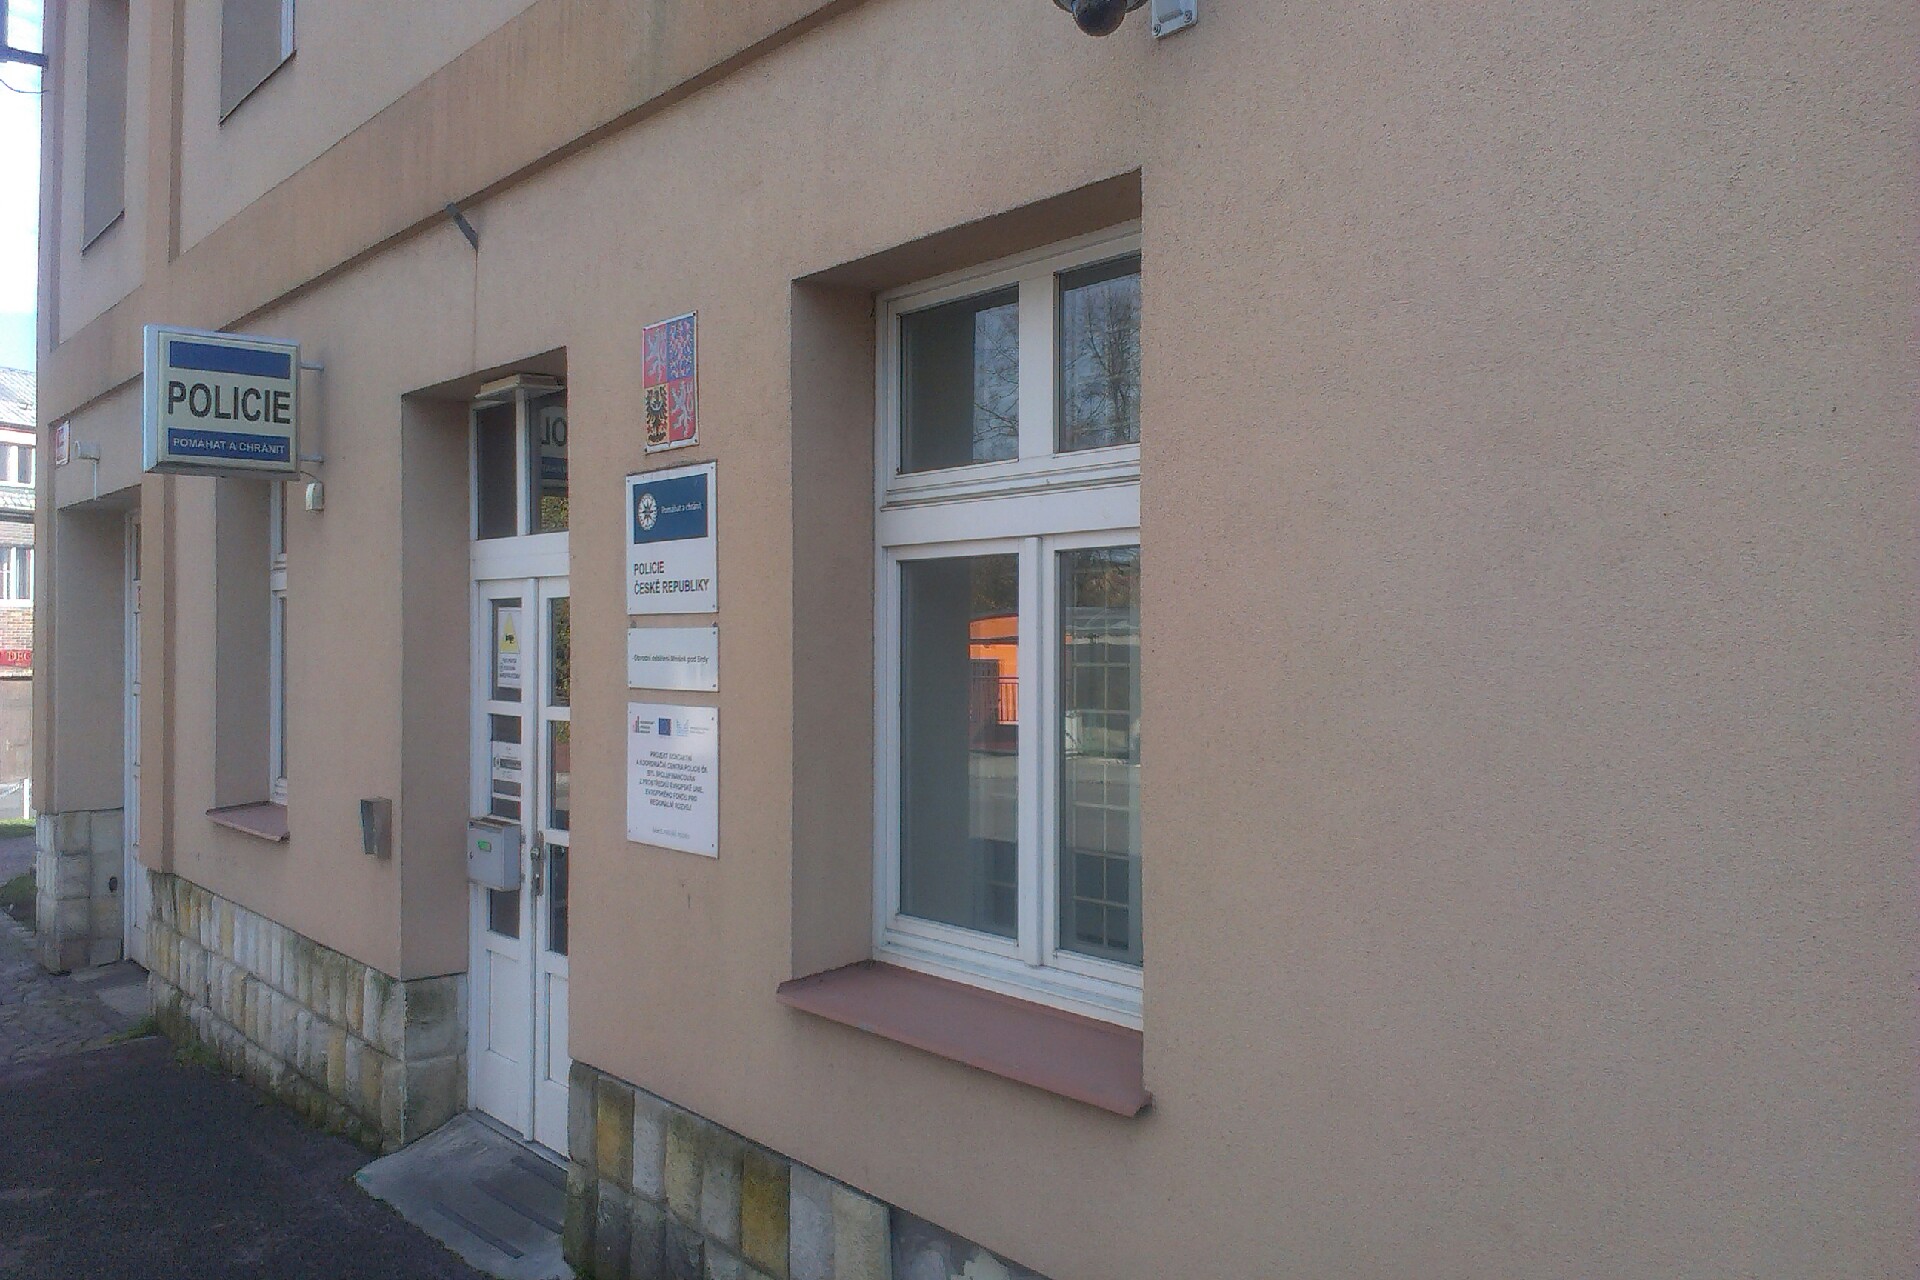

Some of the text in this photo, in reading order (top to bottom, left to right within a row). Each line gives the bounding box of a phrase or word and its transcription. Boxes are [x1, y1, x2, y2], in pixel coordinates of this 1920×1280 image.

[168, 380, 291, 425] POLICIE
[229, 441, 237, 451] A
[634, 561, 665, 576] POLICIE
[634, 578, 710, 595] ČESKÉ REPUBLIKY
